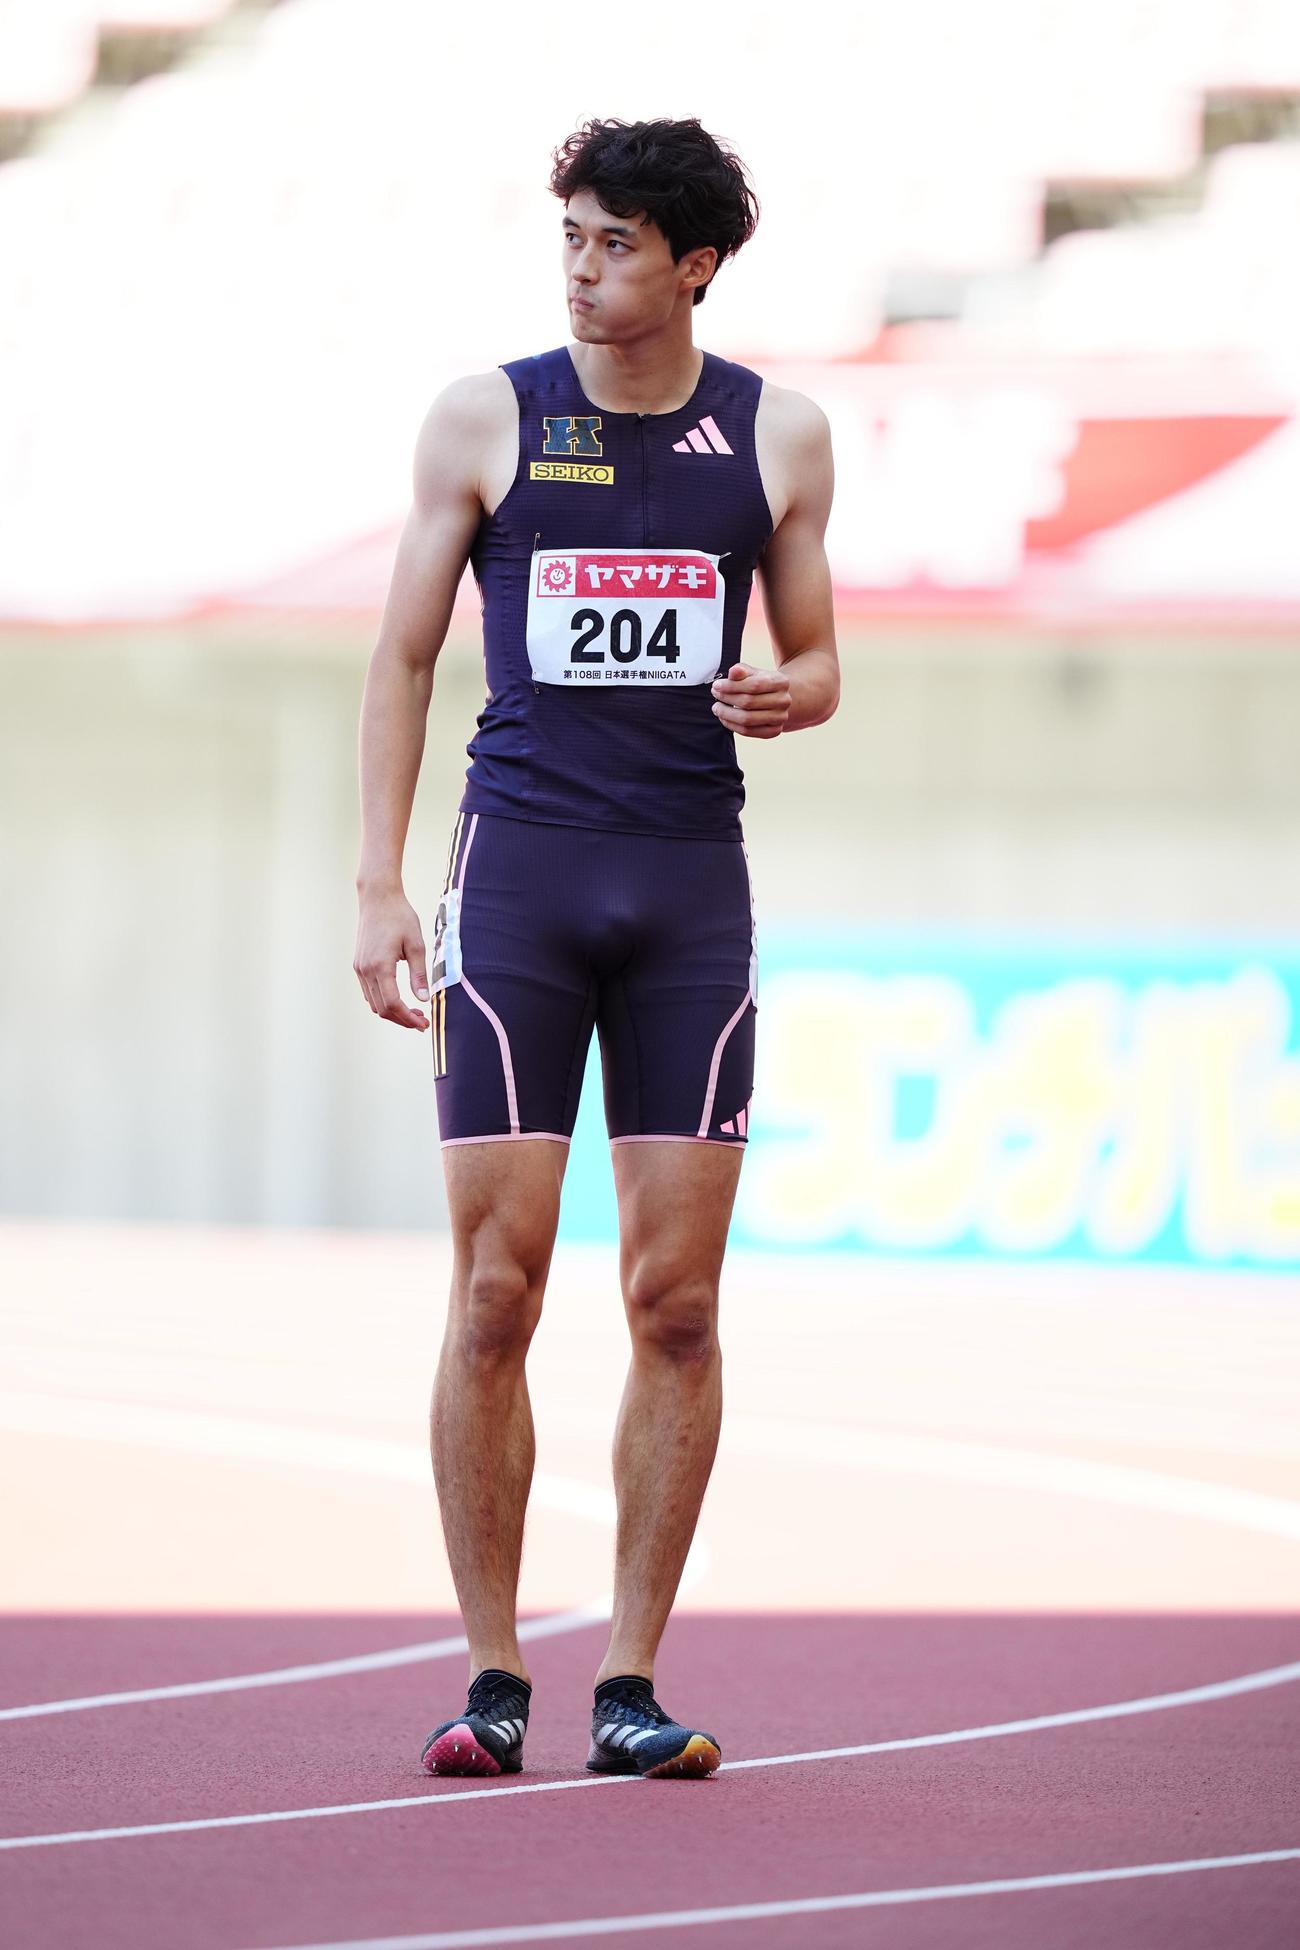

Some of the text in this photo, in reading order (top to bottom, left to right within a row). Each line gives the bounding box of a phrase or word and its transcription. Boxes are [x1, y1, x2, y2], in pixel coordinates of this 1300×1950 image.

[543, 416, 603, 457] K
[534, 463, 609, 482] SEIKO
[584, 564, 707, 589] ヤマザキ
[570, 608, 681, 663] 204
[563, 669, 601, 680] 第108回
